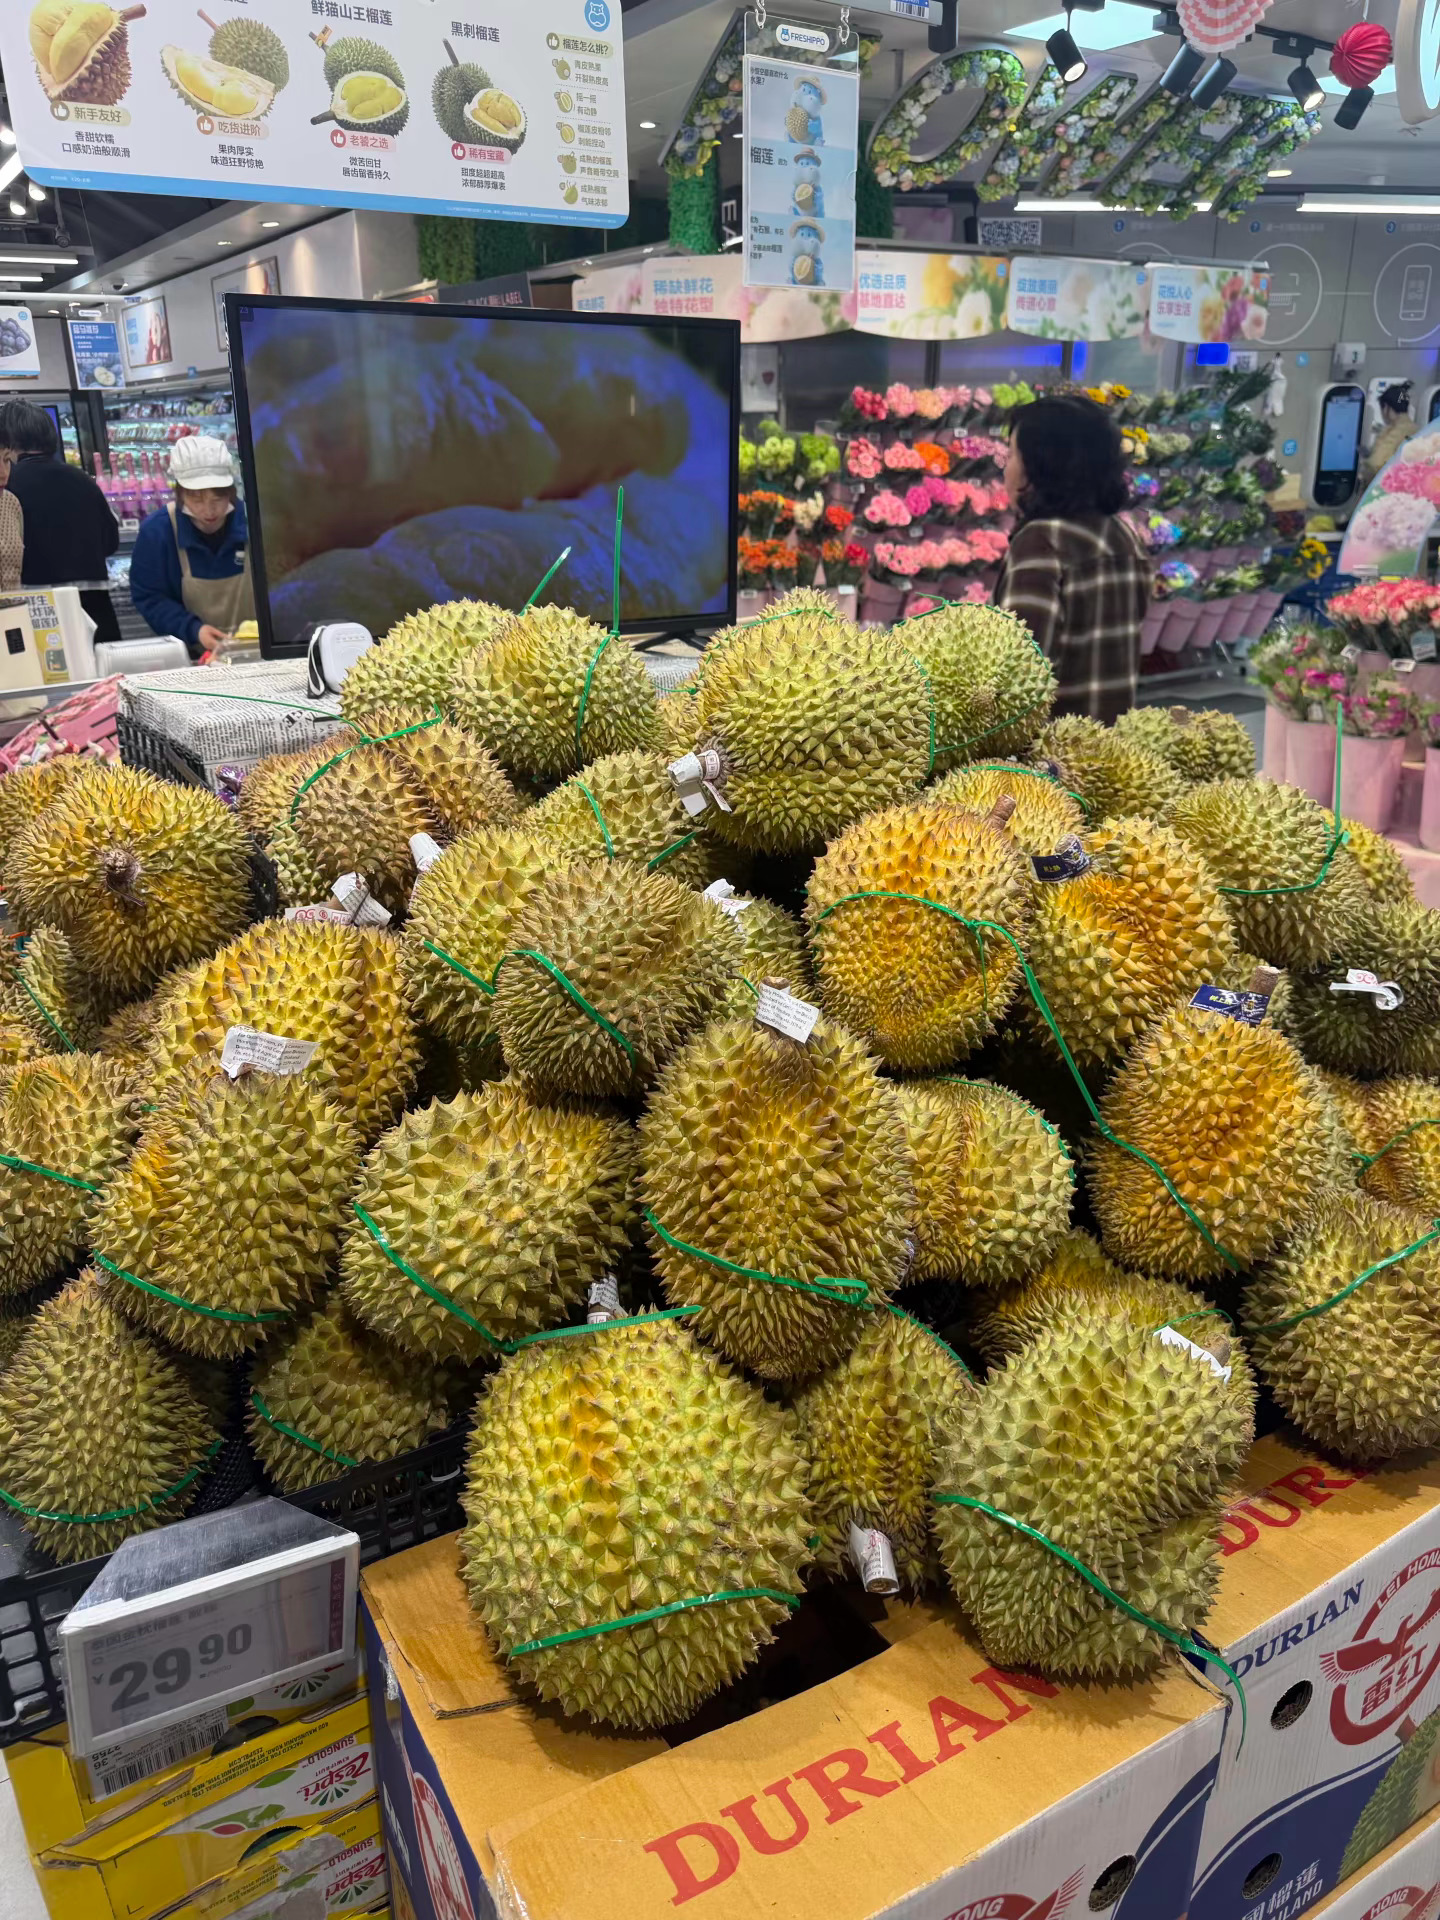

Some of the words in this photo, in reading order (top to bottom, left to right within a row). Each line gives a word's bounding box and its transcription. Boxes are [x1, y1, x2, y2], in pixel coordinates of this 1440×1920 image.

[451, 21, 500, 42] 黑刺榴莲
[790, 32, 826, 46] FRESHIPPO
[562, 38, 609, 55] 榴莲怎么挑?
[74, 106, 122, 122] 新手友好
[74, 131, 115, 144] 香甜软糯
[218, 121, 261, 137] 吃货进阶
[217, 144, 254, 156] 果肉厚实
[468, 147, 505, 162] 稀有宝藏
[349, 156, 381, 169] 微苦回甘
[653, 278, 714, 295] 稀缺鲜花
[859, 273, 906, 289] 优选品质
[654, 296, 714, 314] 独特花型
[859, 292, 905, 309] 基地直达
[1216, 1461, 1376, 1557] DUR
[1375, 1574, 1402, 1607] LEI
[1226, 1579, 1364, 1686] DURIAN
[109, 1647, 191, 1712] 29
[198, 1623, 252, 1665] 90
[269, 1748, 282, 1761] FOR
[281, 1740, 305, 1755] PACKED
[249, 1754, 270, 1771] ZESPRI
[315, 1755, 350, 1777] KIWIFRUIT
[190, 1780, 206, 1793] NEW
[642, 1666, 1061, 1907] DURIAN
[325, 1852, 388, 1901] Zespri
[335, 1857, 369, 1879] KIWIFRUIT
[1370, 1888, 1410, 1919] HONG
